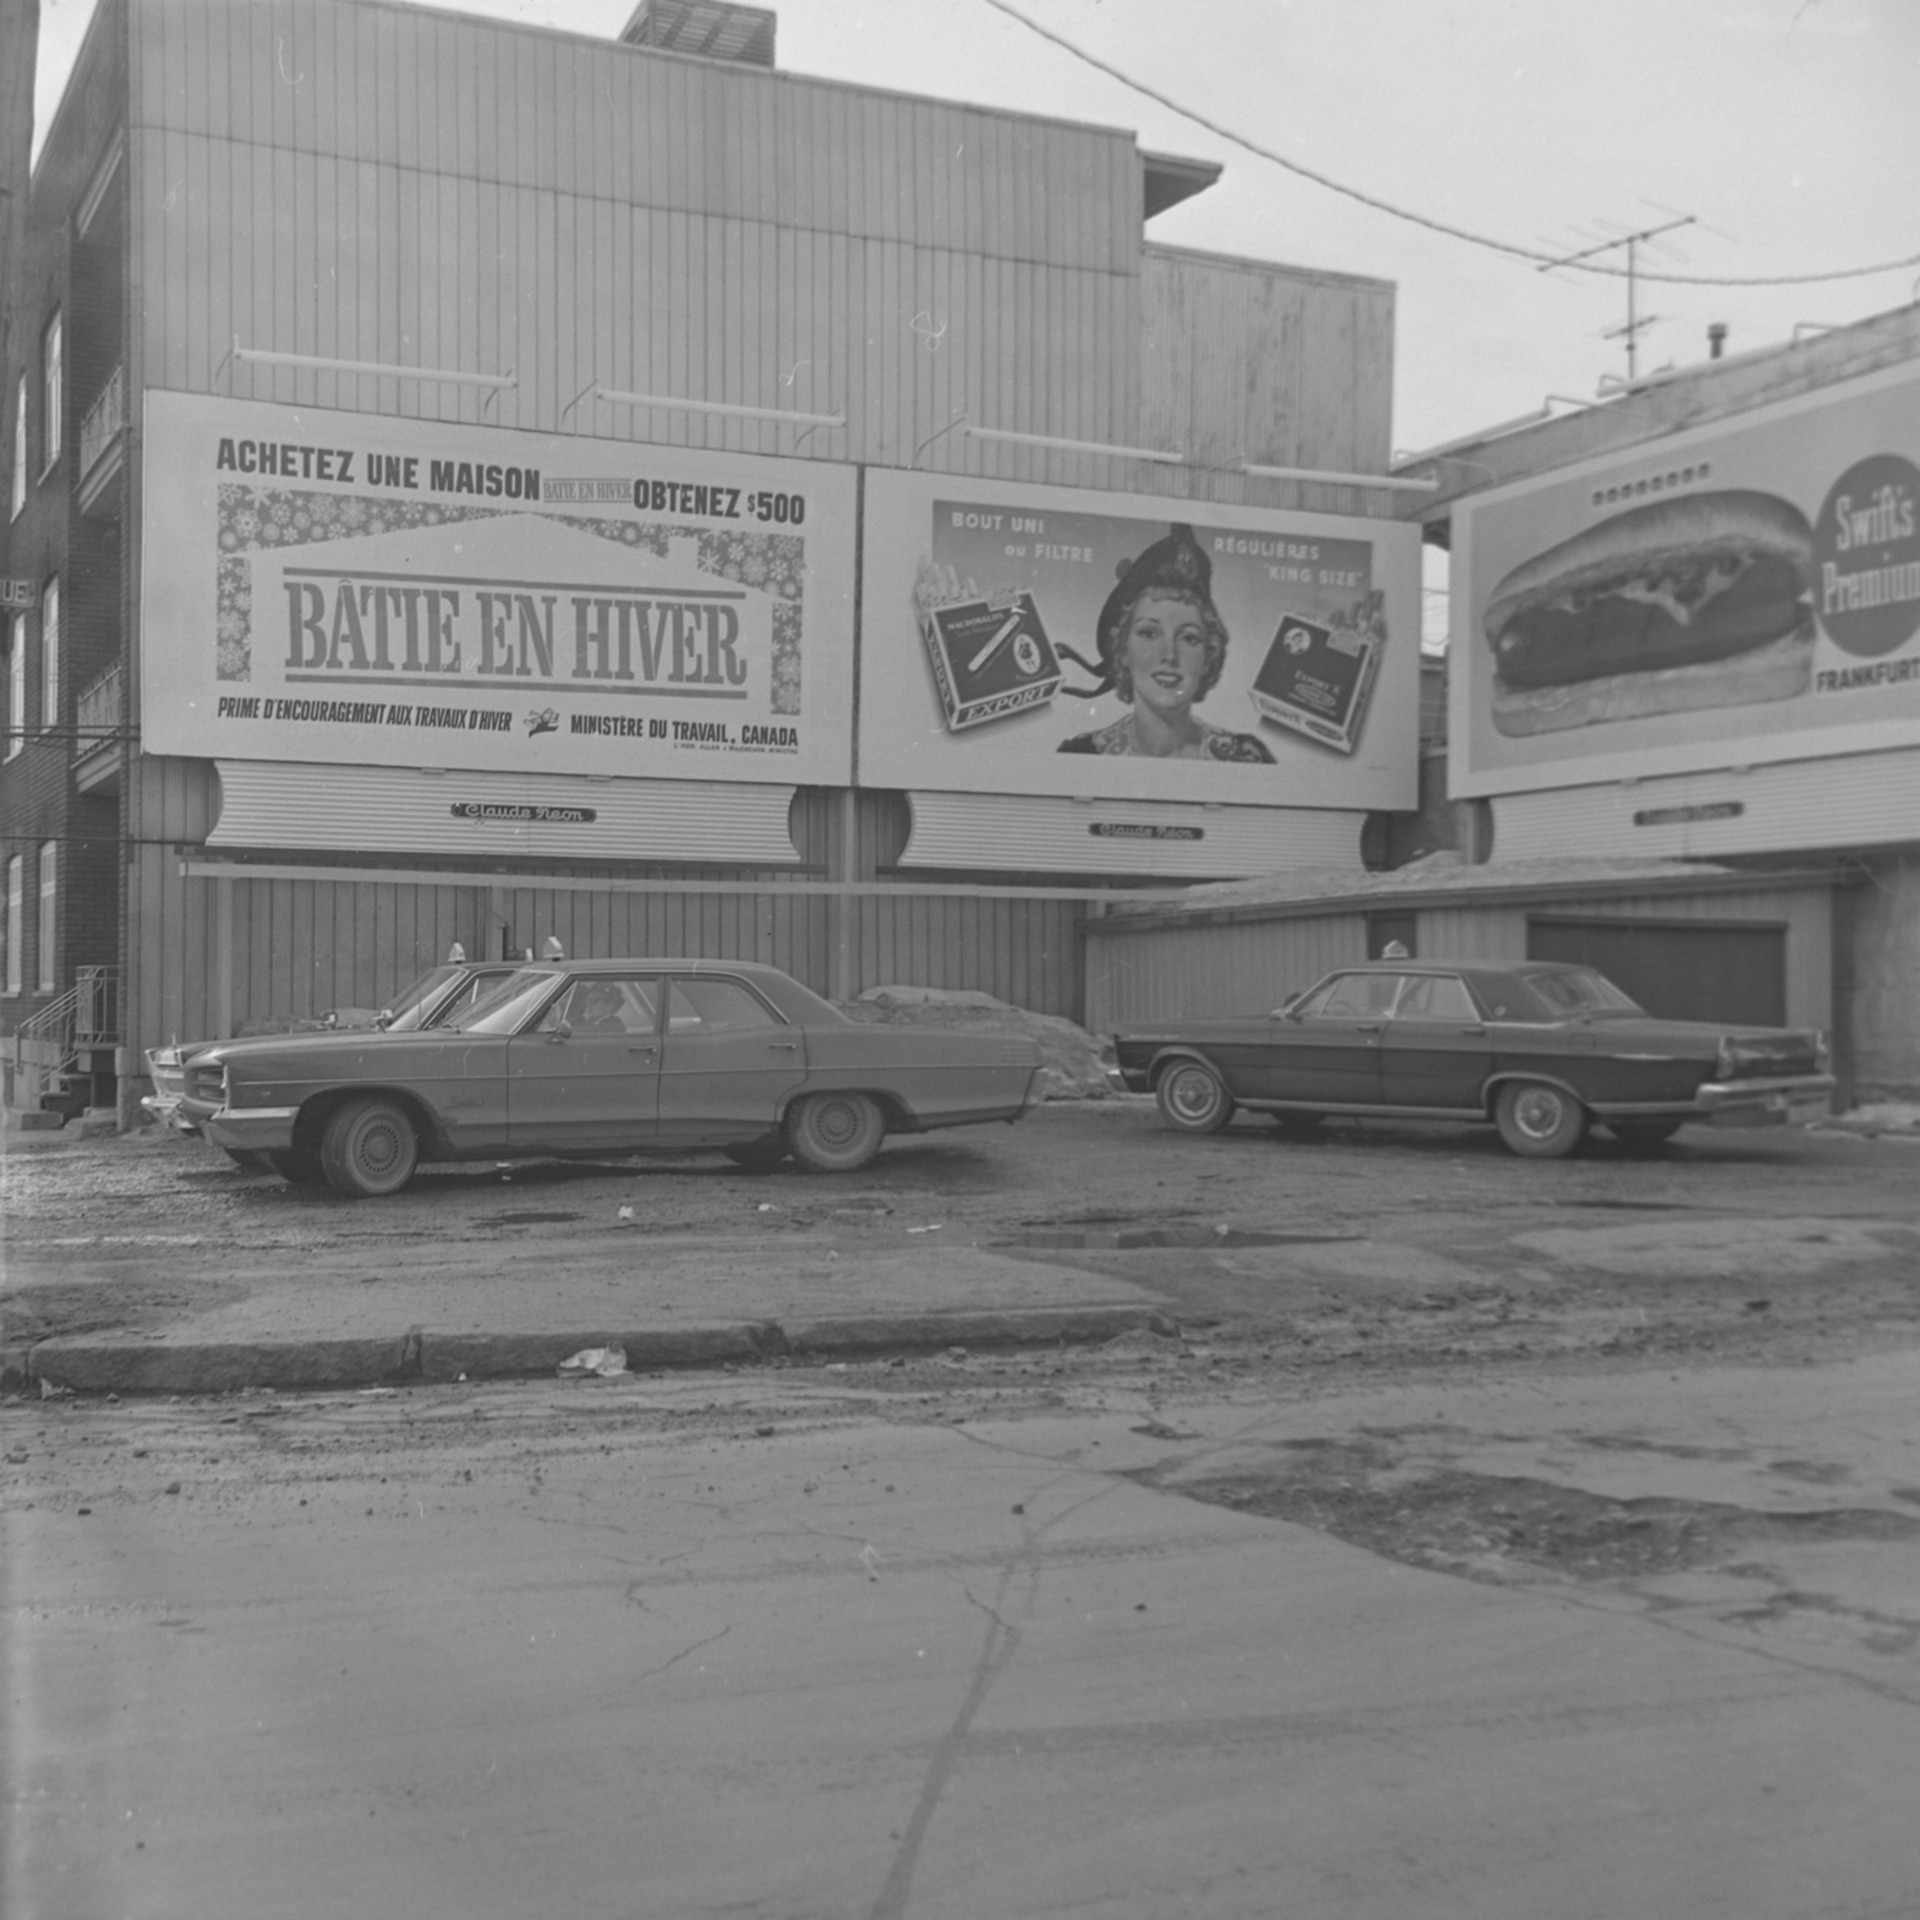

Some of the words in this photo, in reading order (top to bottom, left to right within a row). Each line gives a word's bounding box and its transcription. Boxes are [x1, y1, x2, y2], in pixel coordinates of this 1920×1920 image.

[216, 437, 355, 483] ACHETEZ
[366, 453, 419, 489] UNE
[430, 460, 540, 501] MAISON
[578, 482, 596, 499] EN
[597, 482, 632, 500] HIVER
[633, 478, 741, 519] OBTENEZ
[747, 491, 805, 525] $500
[951, 512, 1003, 531] BOUT
[1011, 516, 1044, 534] UNI
[1835, 484, 1915, 551] Swift's
[1034, 543, 1093, 563] FILTRE
[1213, 535, 1320, 561] RÉGULIÈRES
[283, 578, 462, 674] BÂTIE
[475, 591, 557, 678] EN
[571, 596, 748, 686] HIVER
[217, 696, 261, 719] PRIME
[263, 698, 387, 725] D'ENCOURAGEMENT
[387, 704, 413, 727] AUX
[414, 705, 468, 730] TRAVAUX
[468, 710, 513, 732] D'HIVER
[966, 683, 1051, 721] EXPORT
[571, 714, 643, 737] MINISTÈRE
[649, 719, 668, 739] DU
[742, 724, 798, 747] CANADA
[465, 803, 532, 820] Claude
[535, 806, 584, 822] Neon
[1100, 823, 1153, 838] Claude
[1156, 825, 1195, 840] Neon
